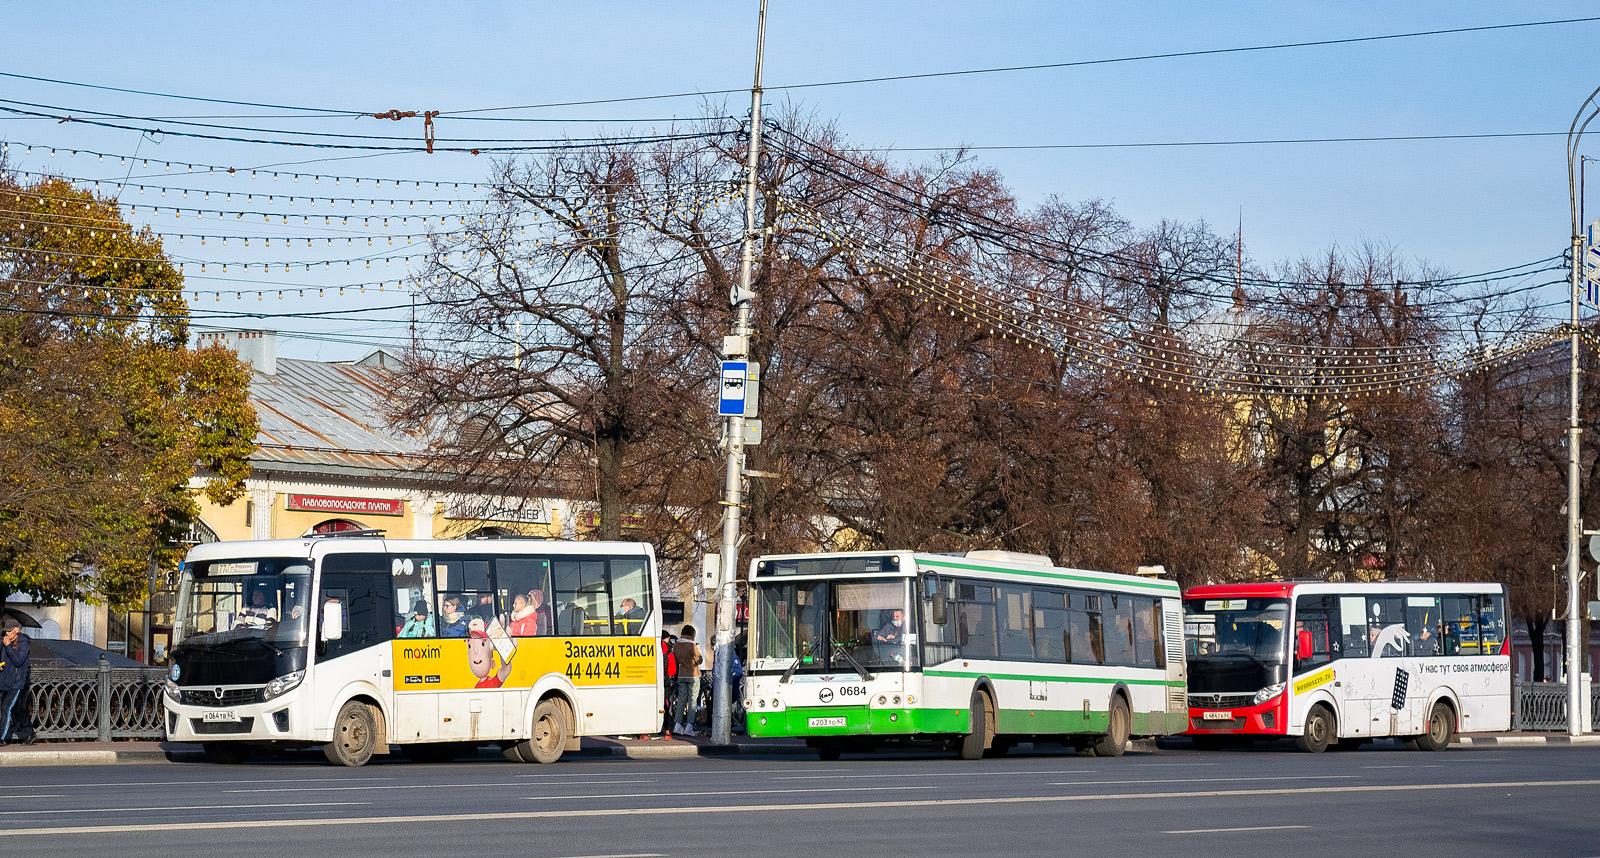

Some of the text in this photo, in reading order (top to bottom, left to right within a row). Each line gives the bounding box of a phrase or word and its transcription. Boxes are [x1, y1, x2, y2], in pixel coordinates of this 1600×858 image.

[302, 497, 391, 511] ПАВЛОВОПОСАДСКИЕ ПЛАТКИ
[1221, 600, 1230, 609] 49
[403, 644, 440, 659] maxim
[565, 640, 654, 659] Закажи такси
[755, 660, 765, 669] 17
[1419, 663, 1424, 674] У
[1439, 665, 1451, 675] тут
[1452, 664, 1469, 673] своя
[1470, 661, 1509, 674] атмосфера!
[1296, 673, 1331, 692] kosmosrzn.ru
[839, 686, 867, 696] 0684
